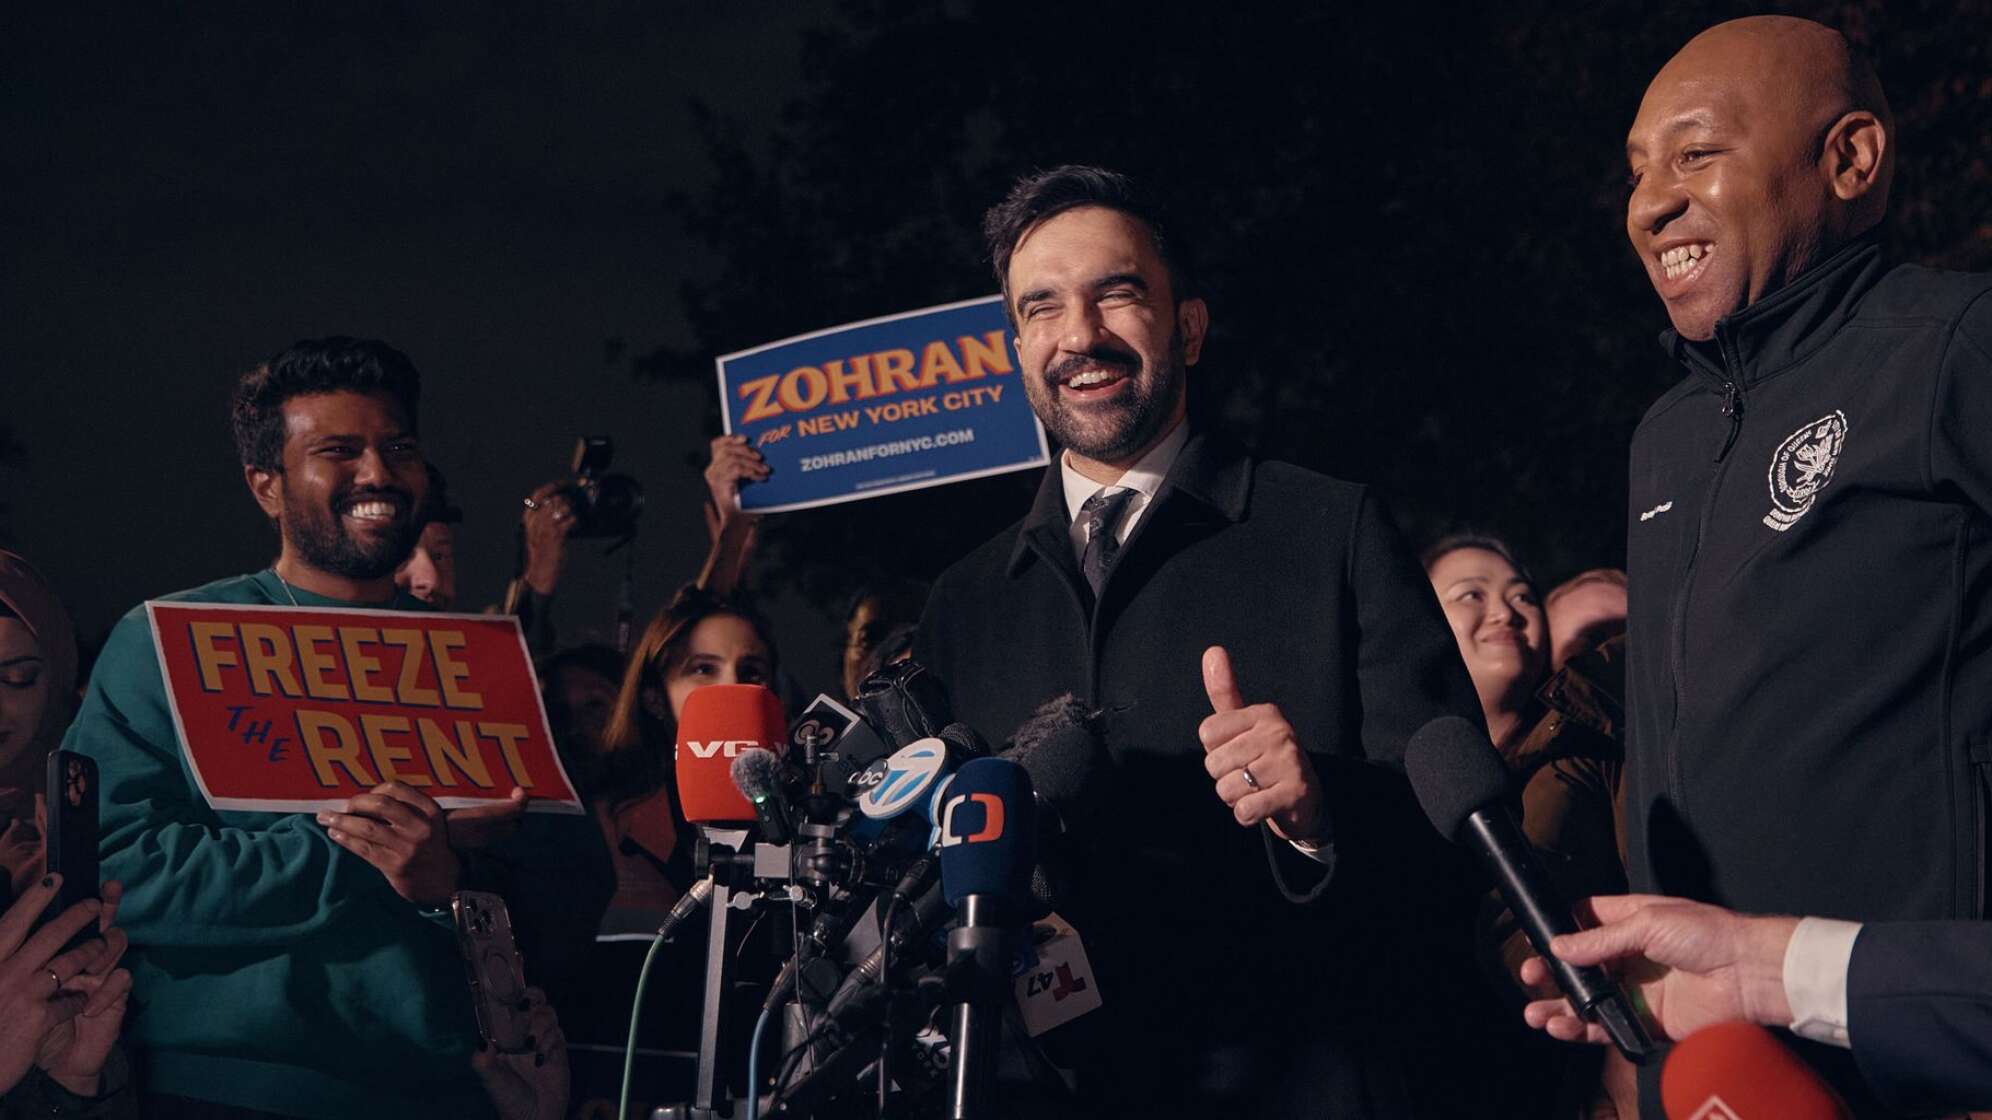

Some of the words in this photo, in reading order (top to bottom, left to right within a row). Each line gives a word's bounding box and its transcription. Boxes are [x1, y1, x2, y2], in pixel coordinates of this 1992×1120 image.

[738, 330, 1014, 424] ZOHRAN
[757, 425, 793, 449] FOR
[797, 410, 860, 438] NEW
[865, 394, 938, 425] YORK
[942, 384, 1004, 411] CITY
[800, 428, 974, 472] ZOHRANFORNYC.COM
[188, 621, 484, 710] FREEZE
[224, 705, 291, 762] THE
[295, 709, 534, 789] RENT
